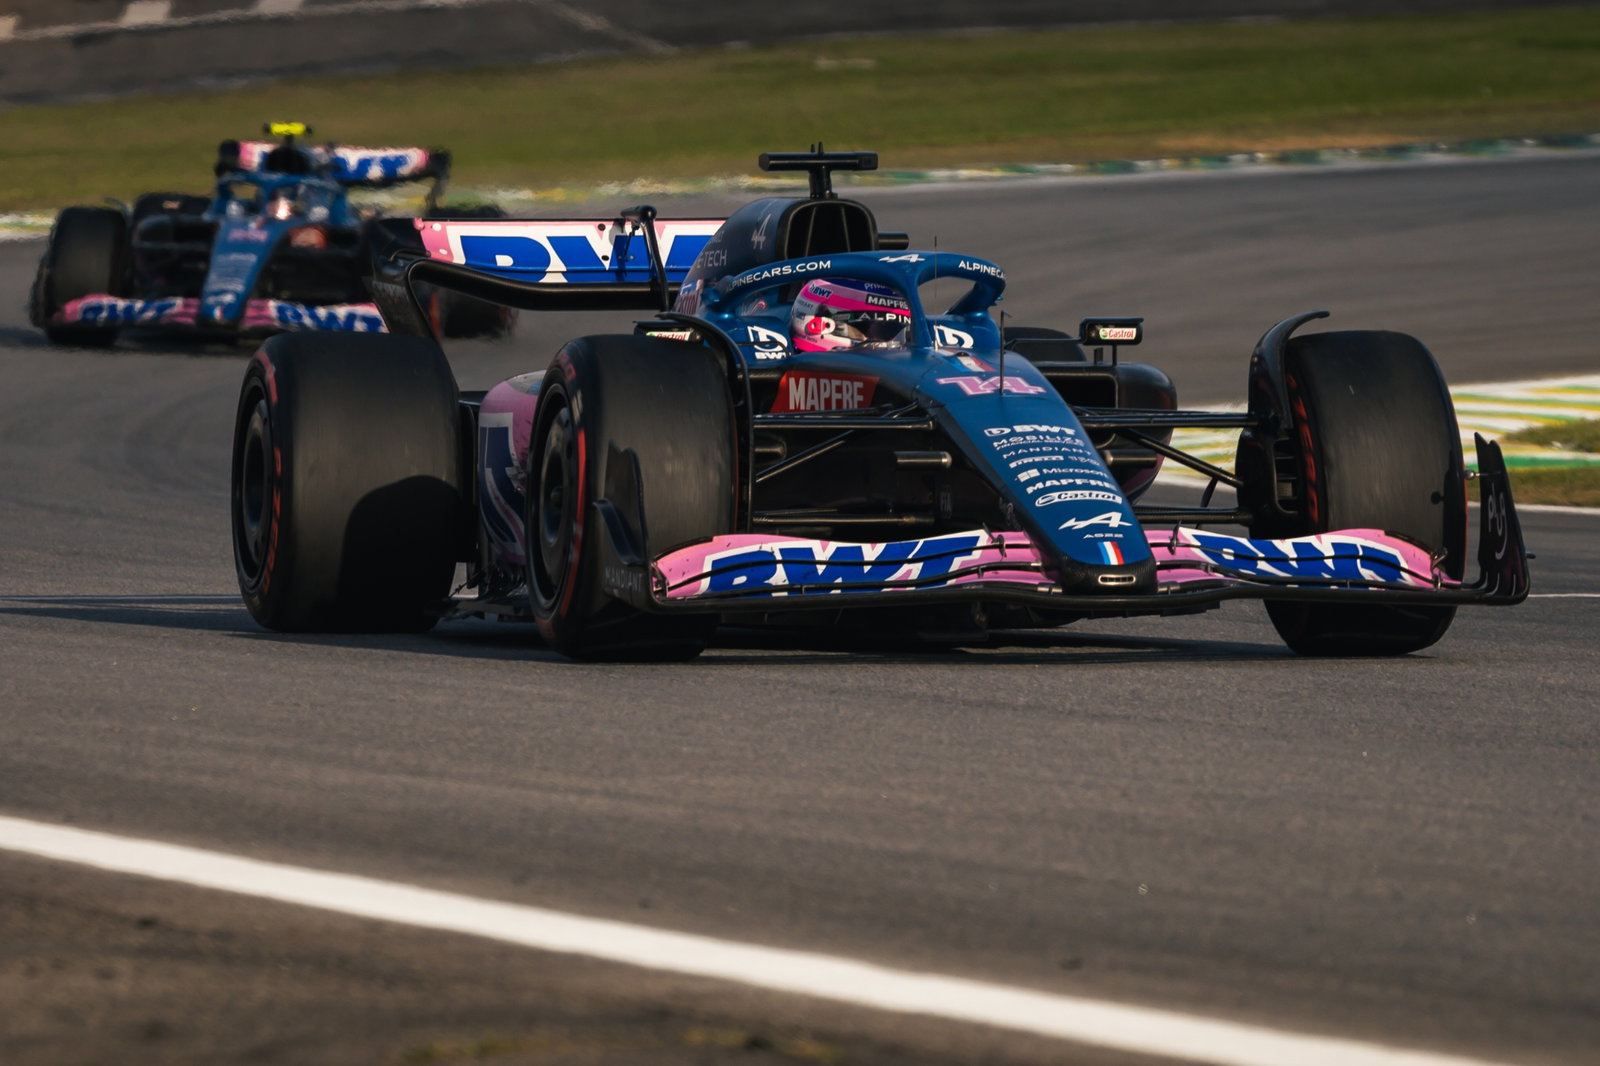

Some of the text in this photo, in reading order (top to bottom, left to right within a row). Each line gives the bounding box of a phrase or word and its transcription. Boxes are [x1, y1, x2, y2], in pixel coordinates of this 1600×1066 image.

[1108, 329, 1134, 338] Castrol
[788, 376, 864, 411] MAPFRE
[936, 376, 1047, 396] 14
[1013, 424, 1076, 436] BWT
[1002, 446, 1092, 460] MANDIANT
[1042, 467, 1110, 479] Microsoft
[1026, 478, 1119, 494] MAPFRE
[1057, 491, 1117, 501] Castrol
[707, 535, 982, 598] BWT
[1192, 534, 1403, 589] BWT
